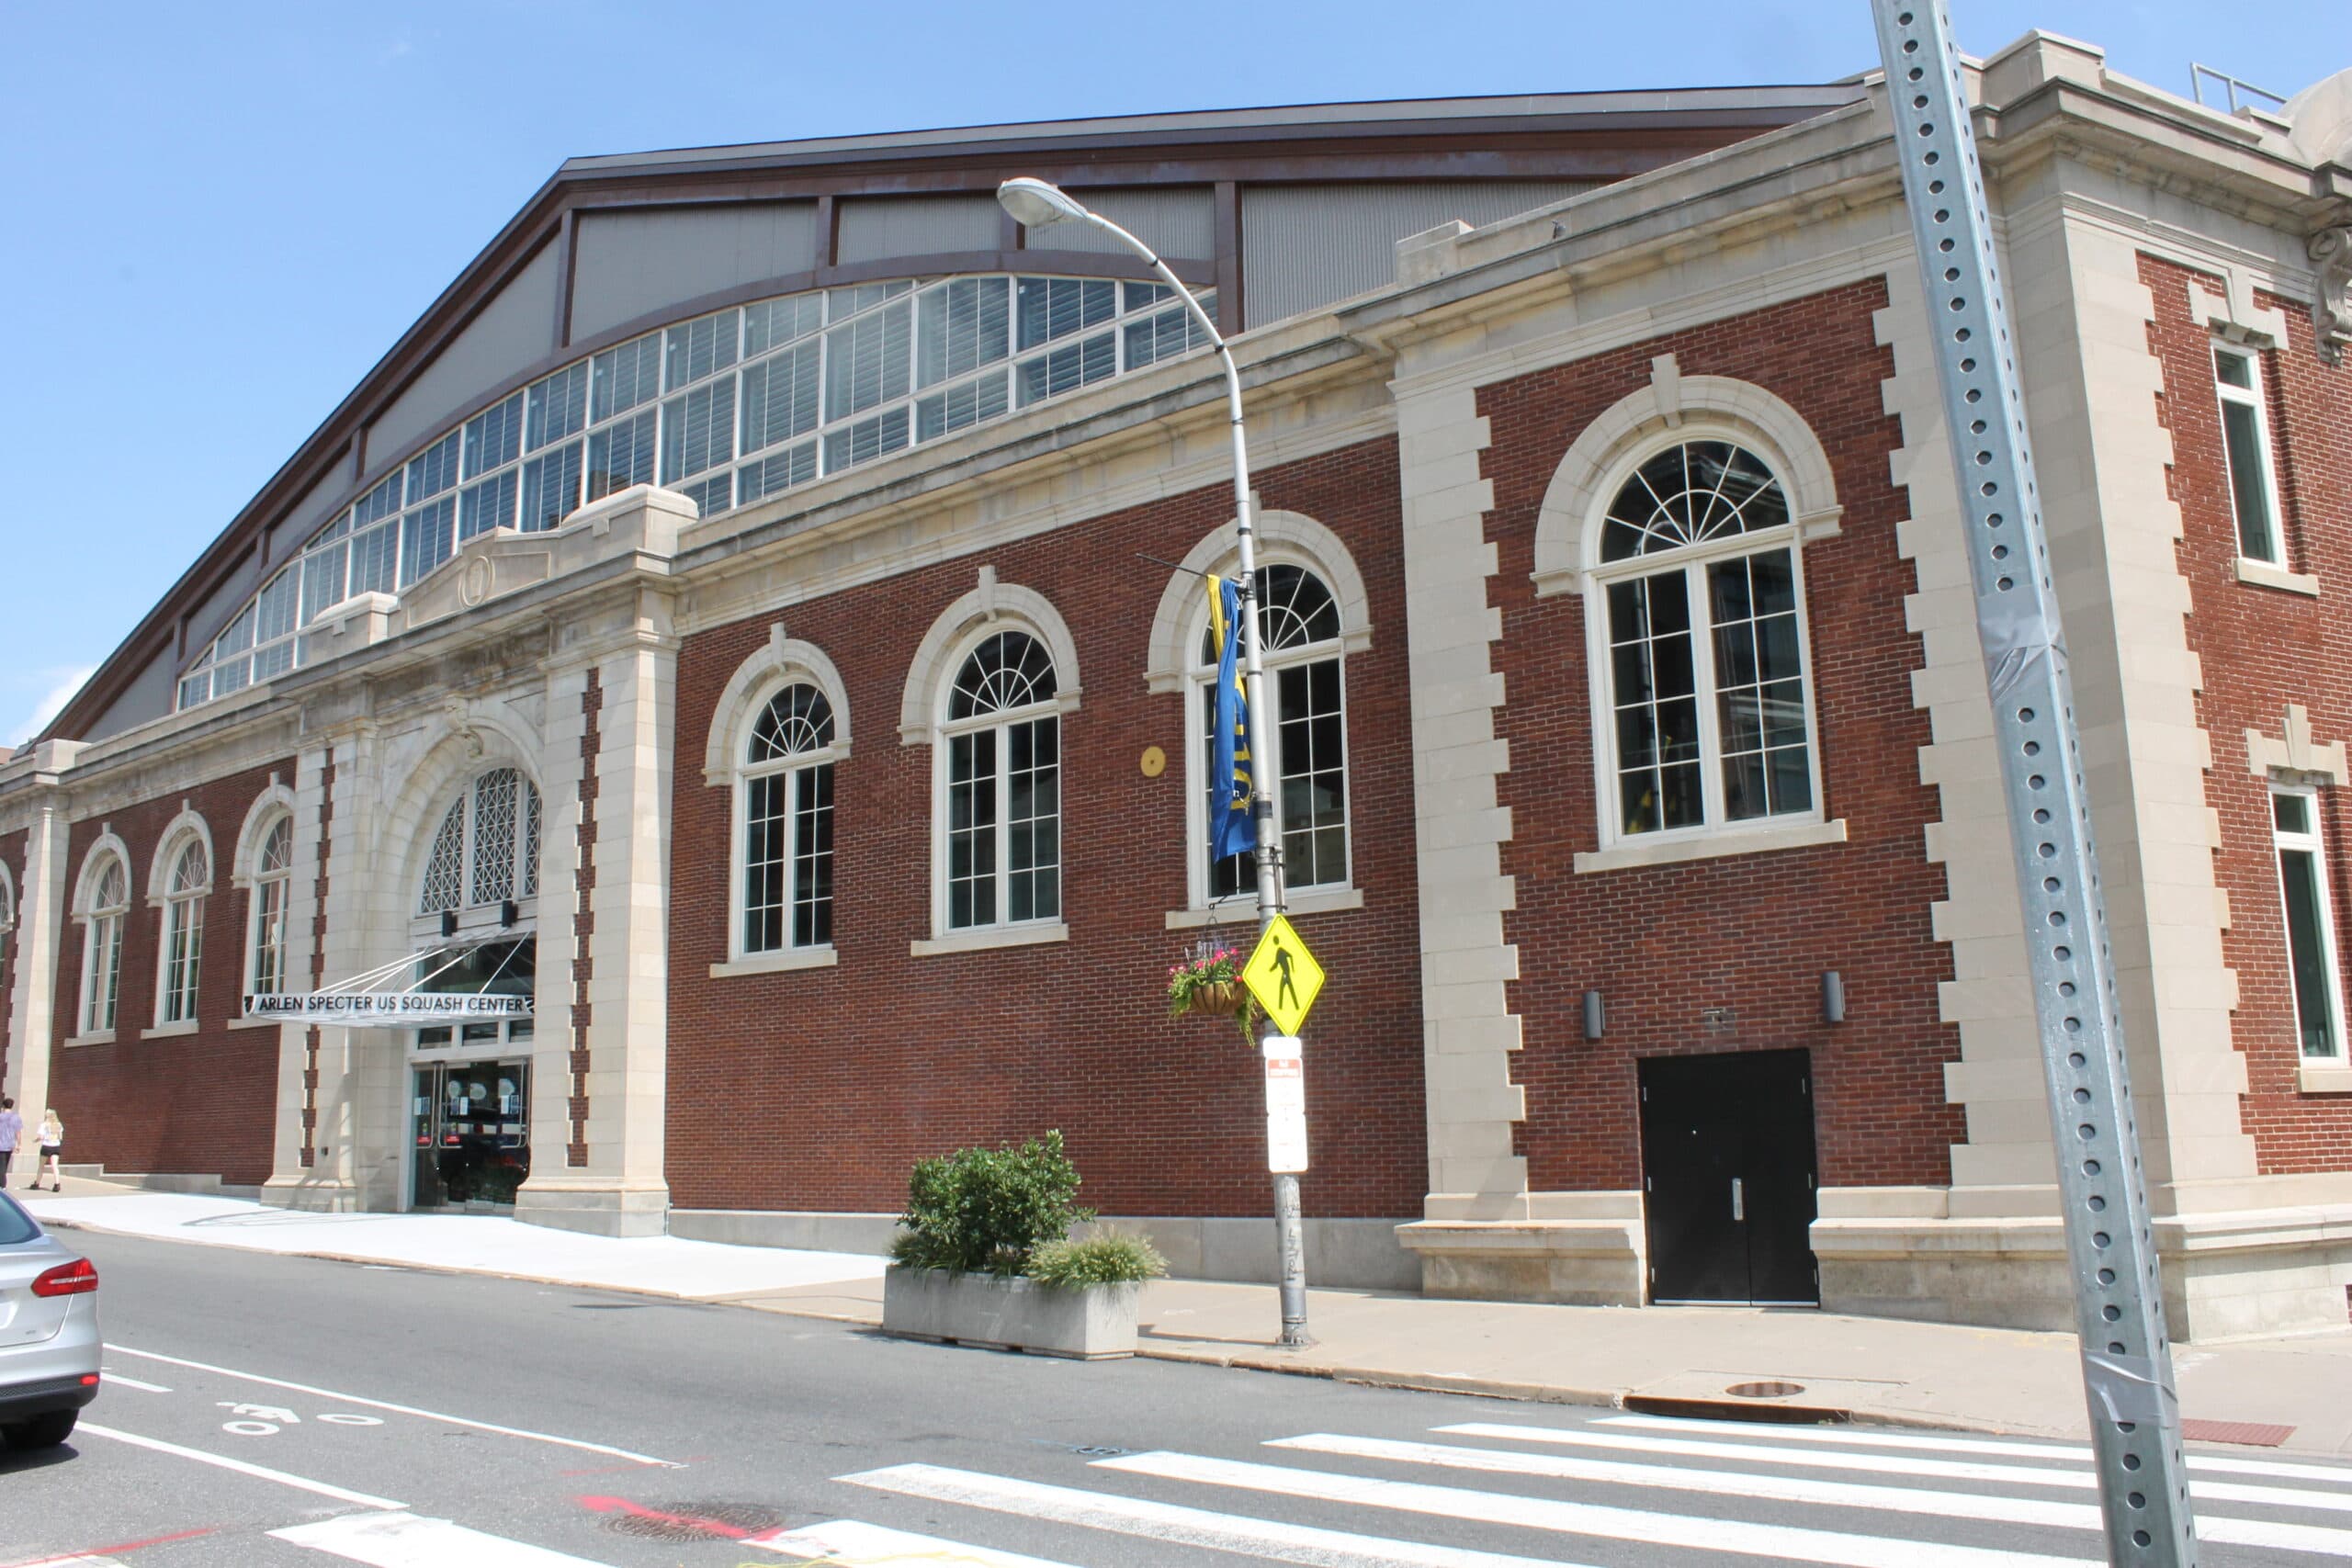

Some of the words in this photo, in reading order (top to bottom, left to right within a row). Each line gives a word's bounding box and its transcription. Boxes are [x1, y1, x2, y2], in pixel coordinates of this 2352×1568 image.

[258, 996, 304, 1010] ARLEN
[308, 996, 373, 1010] SPECTER
[378, 996, 397, 1010] US
[401, 996, 463, 1010] SQUASH
[468, 997, 524, 1011] CENTER
